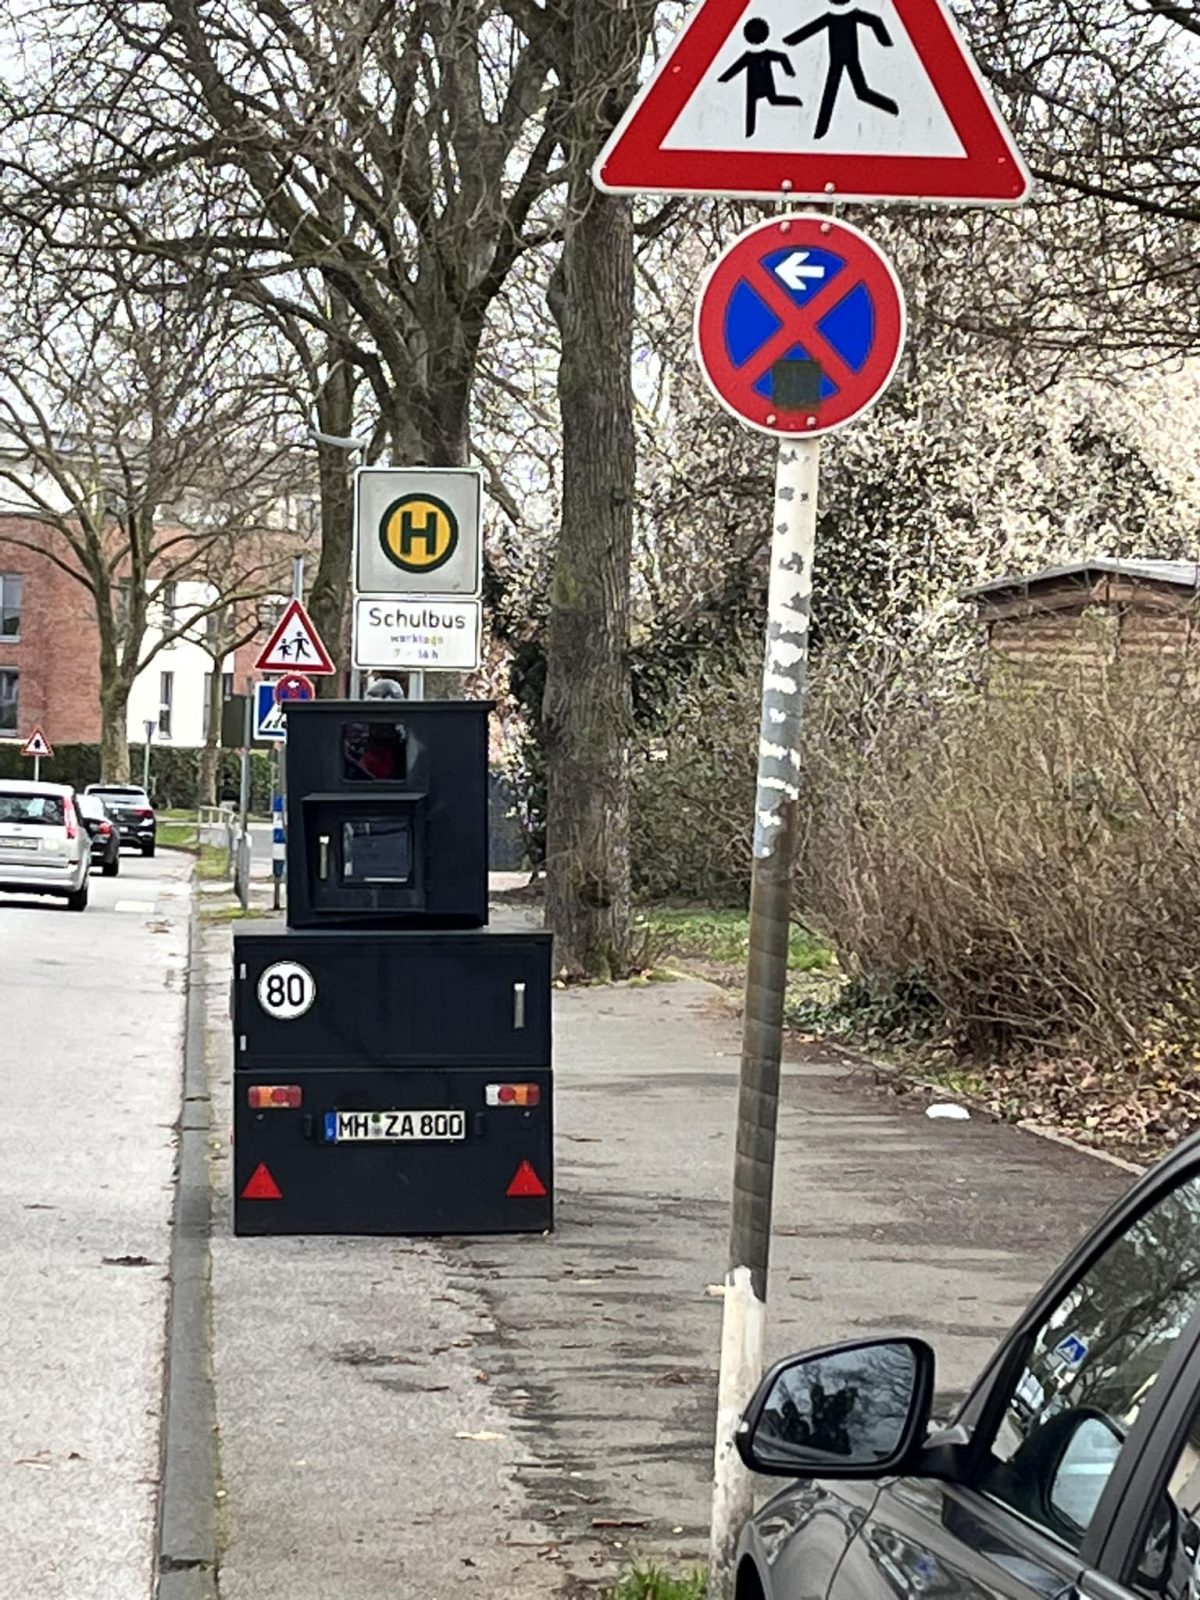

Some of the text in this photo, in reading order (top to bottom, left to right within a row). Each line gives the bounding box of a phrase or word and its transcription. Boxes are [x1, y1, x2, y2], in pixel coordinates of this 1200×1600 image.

[400, 512, 437, 555] H
[369, 607, 466, 629] Schulbus
[267, 974, 304, 1007] 80
[338, 1115, 368, 1137] MH
[385, 1115, 414, 1136] ZA
[420, 1114, 462, 1136] 800
